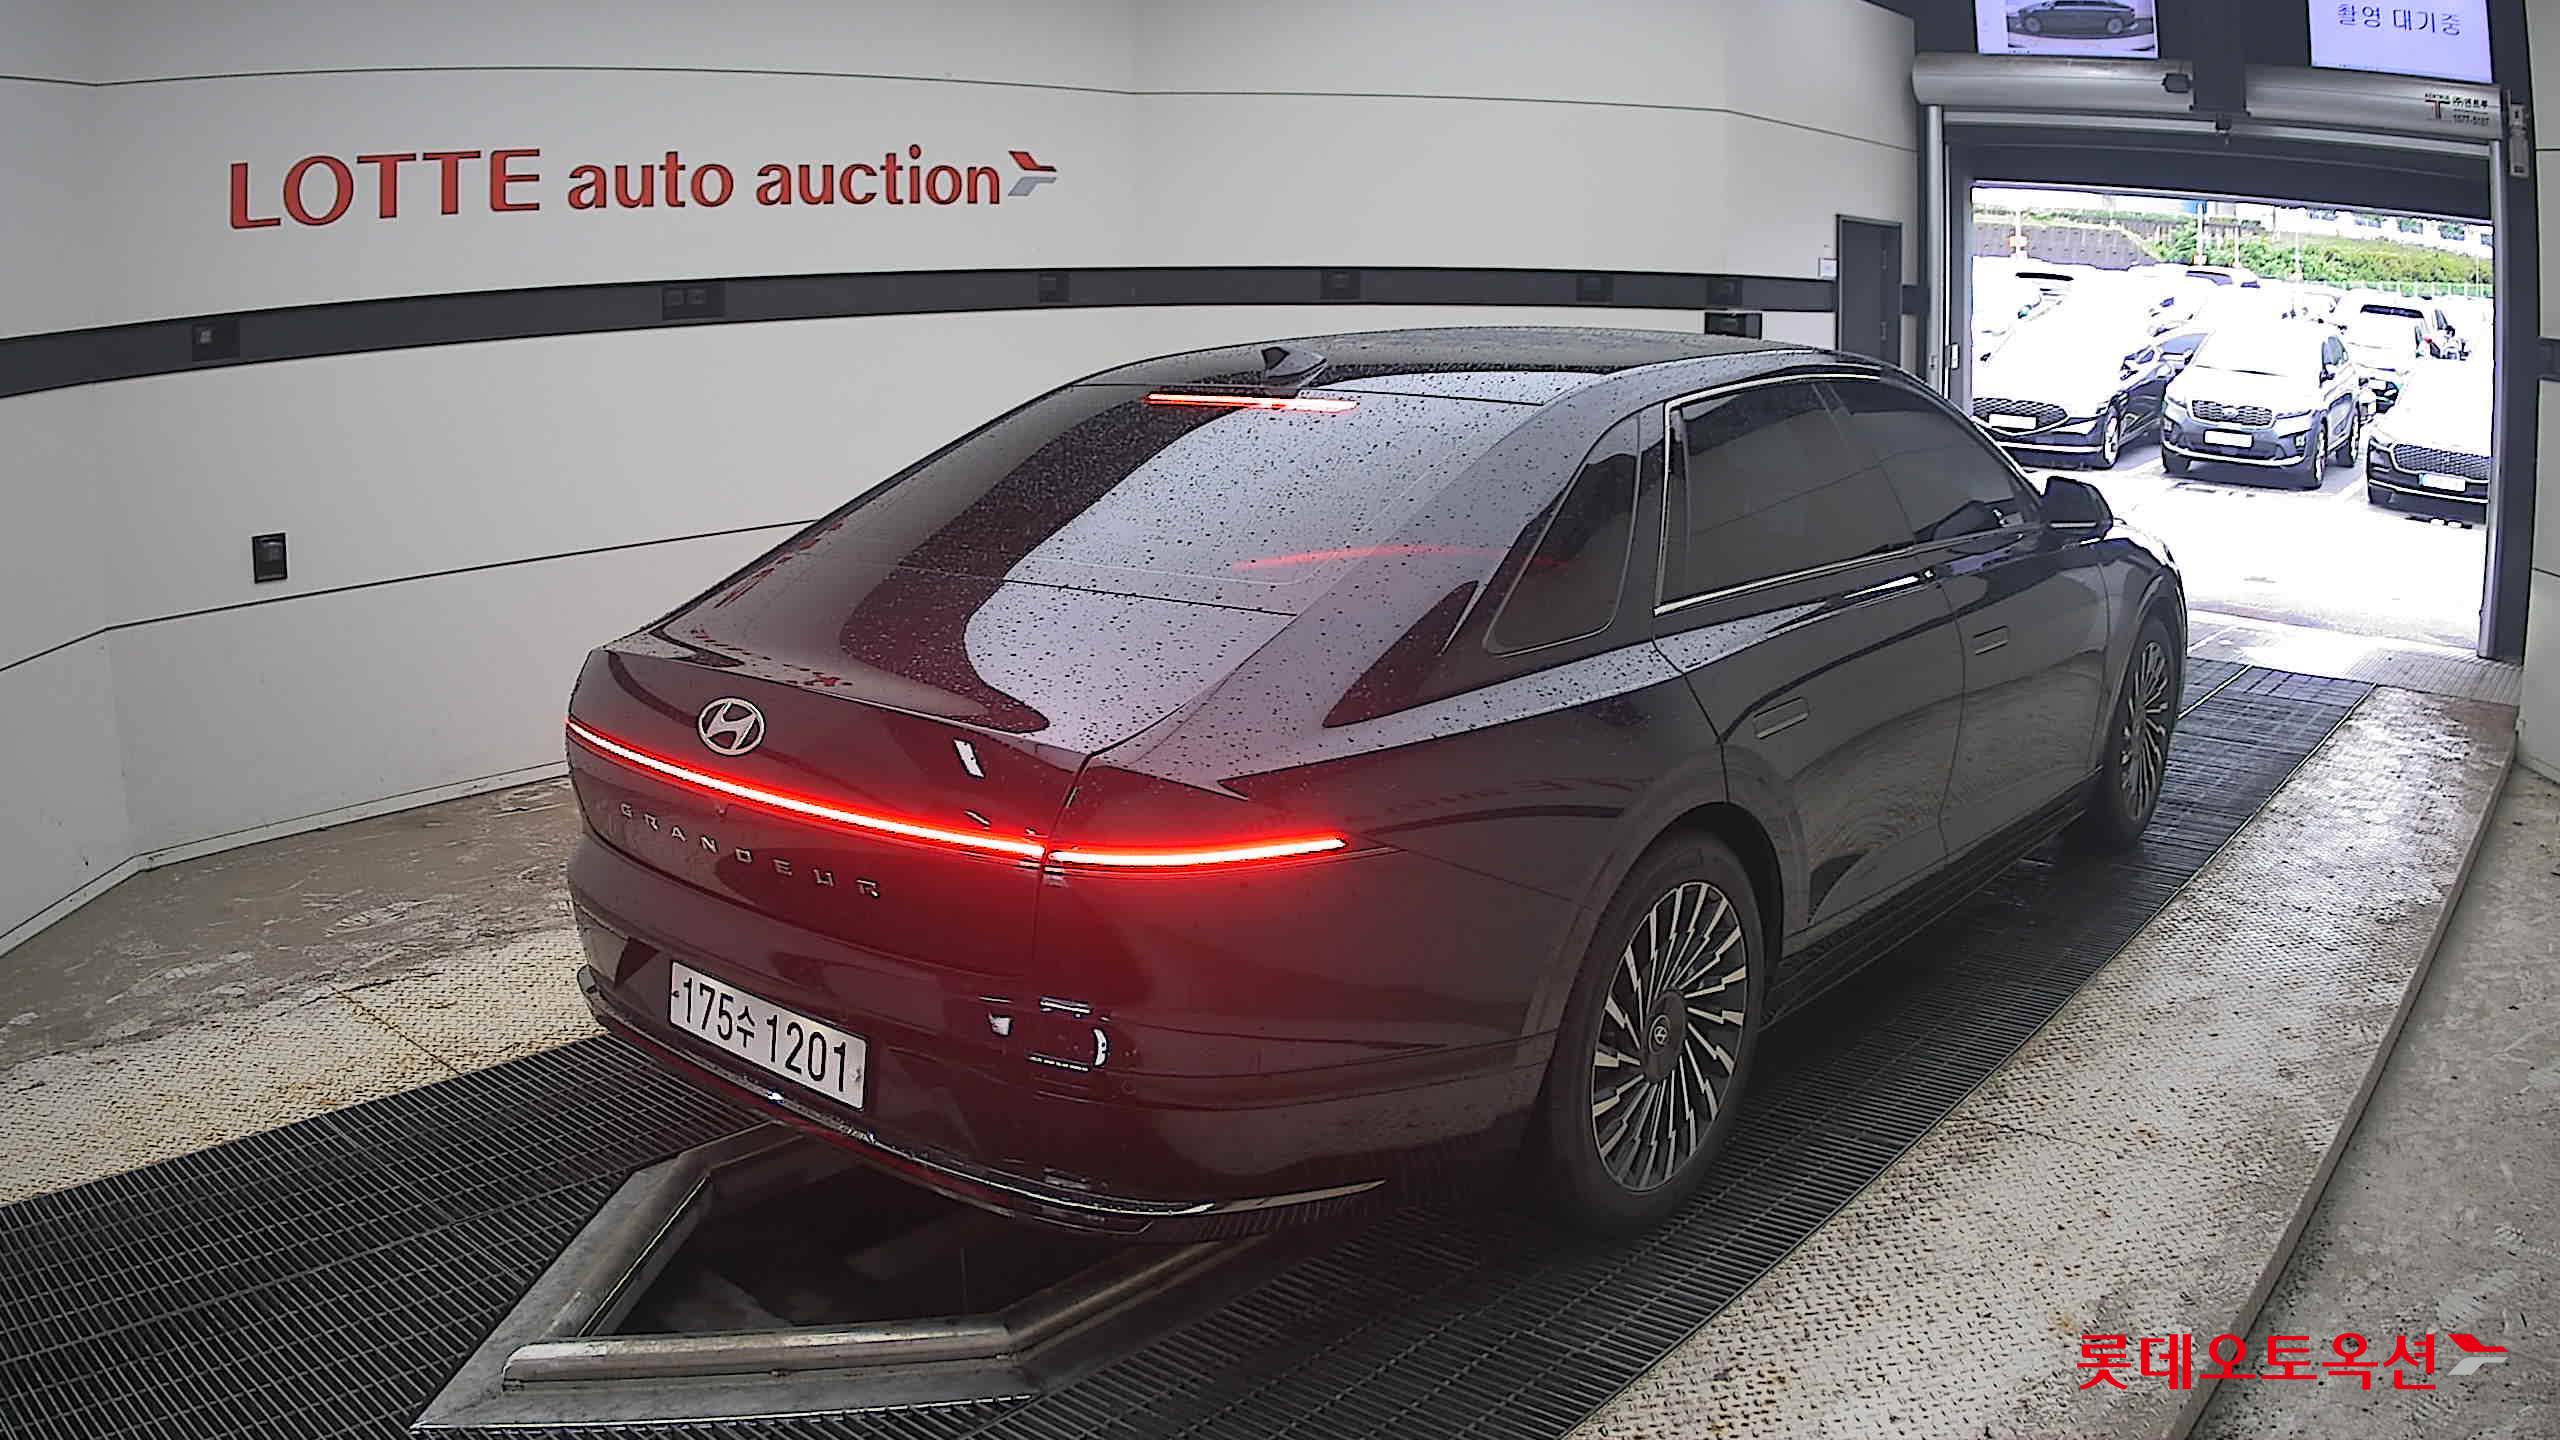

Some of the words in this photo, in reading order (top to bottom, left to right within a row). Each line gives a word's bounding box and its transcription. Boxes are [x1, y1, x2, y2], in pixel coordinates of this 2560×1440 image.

[2338, 4, 2381, 28] 촬영
[2393, 9, 2461, 36] 대기중
[230, 148, 541, 229] LOTTE
[568, 150, 734, 208] auto
[756, 144, 1001, 205] auction
[620, 803, 880, 897] GRANDEUR
